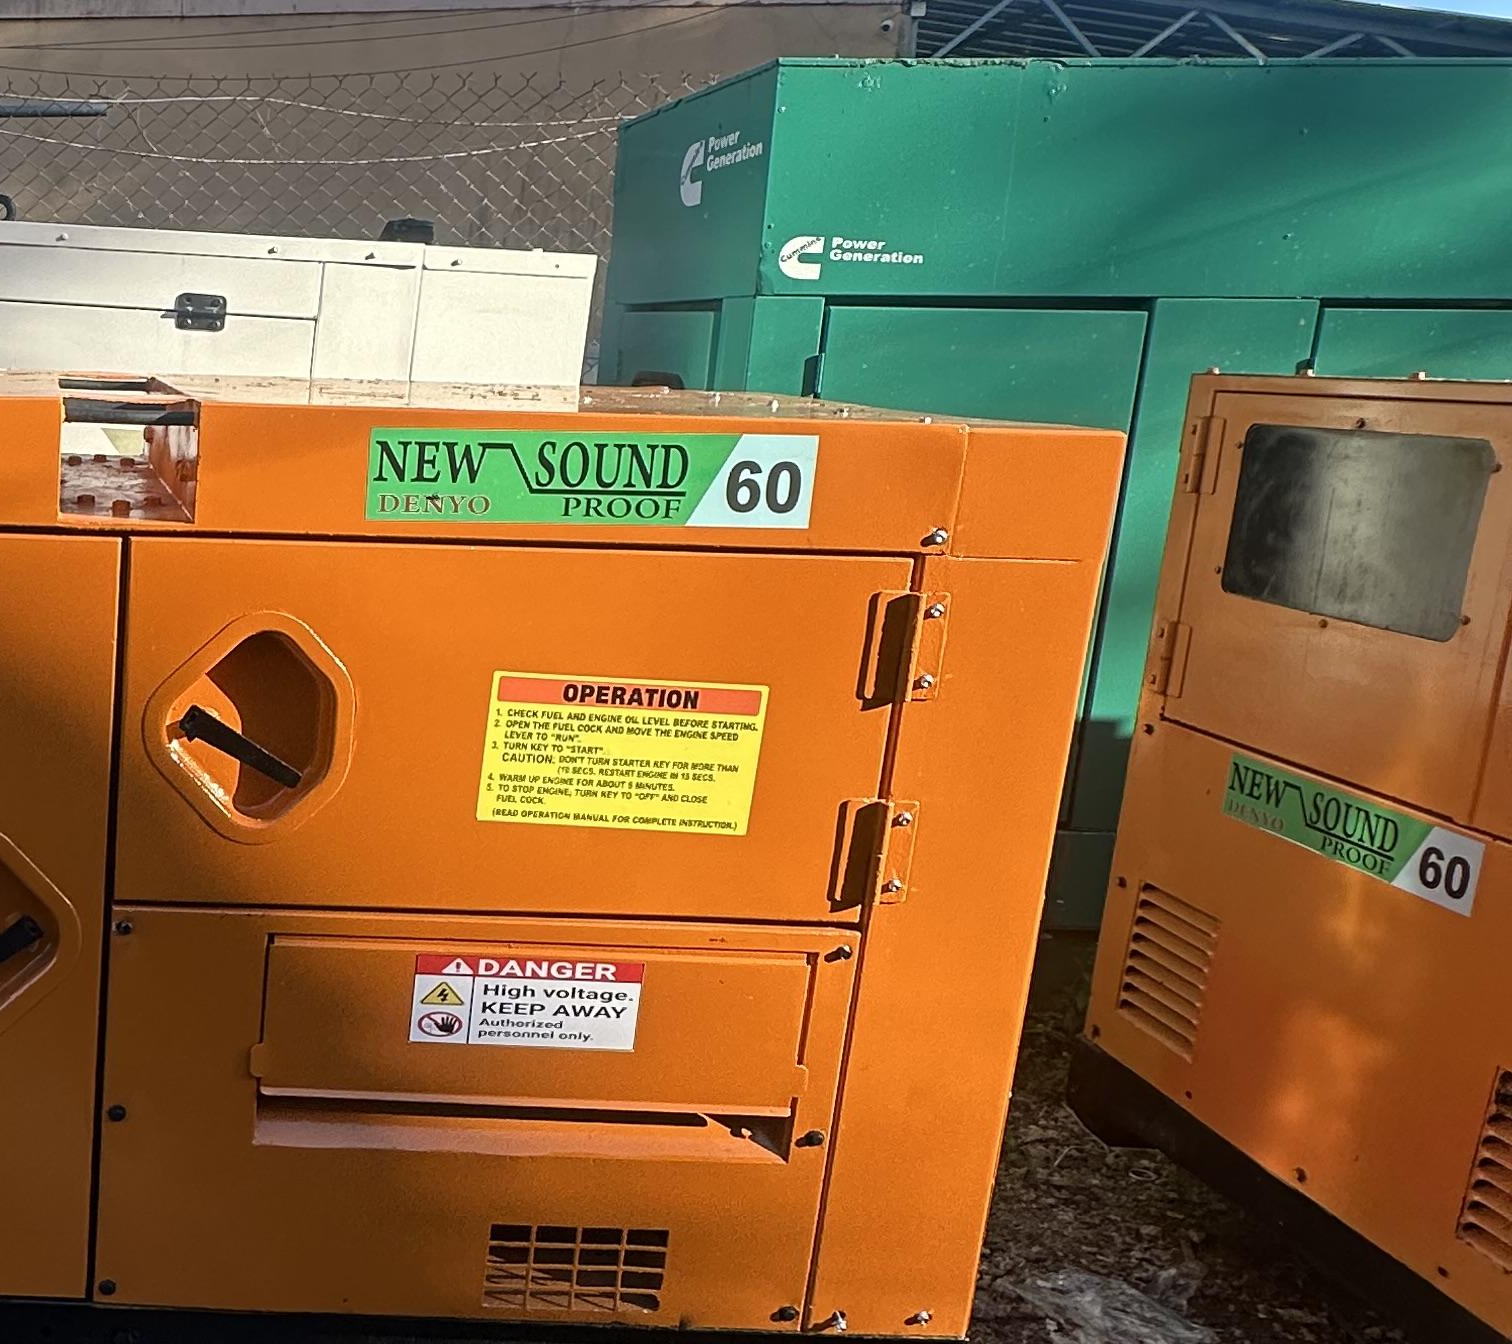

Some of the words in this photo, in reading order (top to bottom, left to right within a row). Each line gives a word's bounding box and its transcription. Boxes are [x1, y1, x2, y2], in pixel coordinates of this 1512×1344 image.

[708, 131, 740, 153] Power
[706, 142, 763, 172] Generation
[831, 236, 886, 250] Power
[829, 249, 924, 264] Generation
[373, 440, 488, 485] NEW
[534, 440, 689, 490] SOUND
[725, 460, 802, 515] 60
[377, 493, 491, 516] DENYO
[560, 496, 683, 520] PROOF
[562, 683, 699, 710] OPERATION
[508, 708, 538, 718] CHECK
[541, 710, 564, 720] FUEL
[567, 712, 586, 721] AND
[589, 713, 623, 723] ENGINE
[642, 716, 671, 726] LEVEL
[673, 718, 709, 728] BEFORE
[504, 730, 534, 740] LEVER
[536, 732, 548, 741] TO
[506, 719, 530, 729] OPEN
[533, 721, 550, 731] THE
[553, 722, 575, 732] FUEL
[577, 723, 603, 733] COCK
[605, 725, 625, 735] AND
[626, 726, 652, 736] MOVE
[655, 728, 672, 738] THE
[674, 729, 708, 739] ENGINE
[710, 732, 739, 741] SPEED
[503, 741, 528, 751] TURN
[531, 743, 548, 752] KEY
[551, 744, 564, 753] TO
[588, 757, 610, 766] TURN
[612, 758, 650, 768] STARTER
[653, 760, 670, 769] KEY
[672, 761, 689, 771] FOR
[717, 764, 740, 773] THAN
[499, 773, 527, 783] WARM
[529, 775, 541, 783] UP
[576, 778, 594, 787] FOR
[596, 779, 626, 788] ABOUT
[692, 773, 716, 782] SECS.
[496, 794, 518, 803] FUEL
[498, 784, 510, 792] TO
[512, 785, 535, 794] STOP
[575, 788, 598, 798] TURN
[600, 790, 618, 799] KEY
[621, 791, 632, 799] TO
[661, 794, 679, 802] AND
[681, 795, 708, 804] CLOSE
[521, 809, 571, 820] OPERATION
[573, 812, 610, 822] MANUAL
[612, 814, 630, 823] FOR
[632, 816, 677, 826] COMPLETE
[1228, 762, 1288, 808] NEW
[1309, 791, 1399, 853] SOUND
[1418, 846, 1472, 900] 60
[1319, 836, 1392, 875] PROOF
[478, 958, 617, 982] DANGER
[483, 983, 536, 1000] High
[543, 987, 634, 1004] voltage.
[481, 1001, 546, 1016] KEEP
[552, 1005, 628, 1019] AWAY
[478, 1018, 563, 1030] Authorized
[478, 1028, 554, 1040] personnel
[558, 1031, 594, 1043] only.
